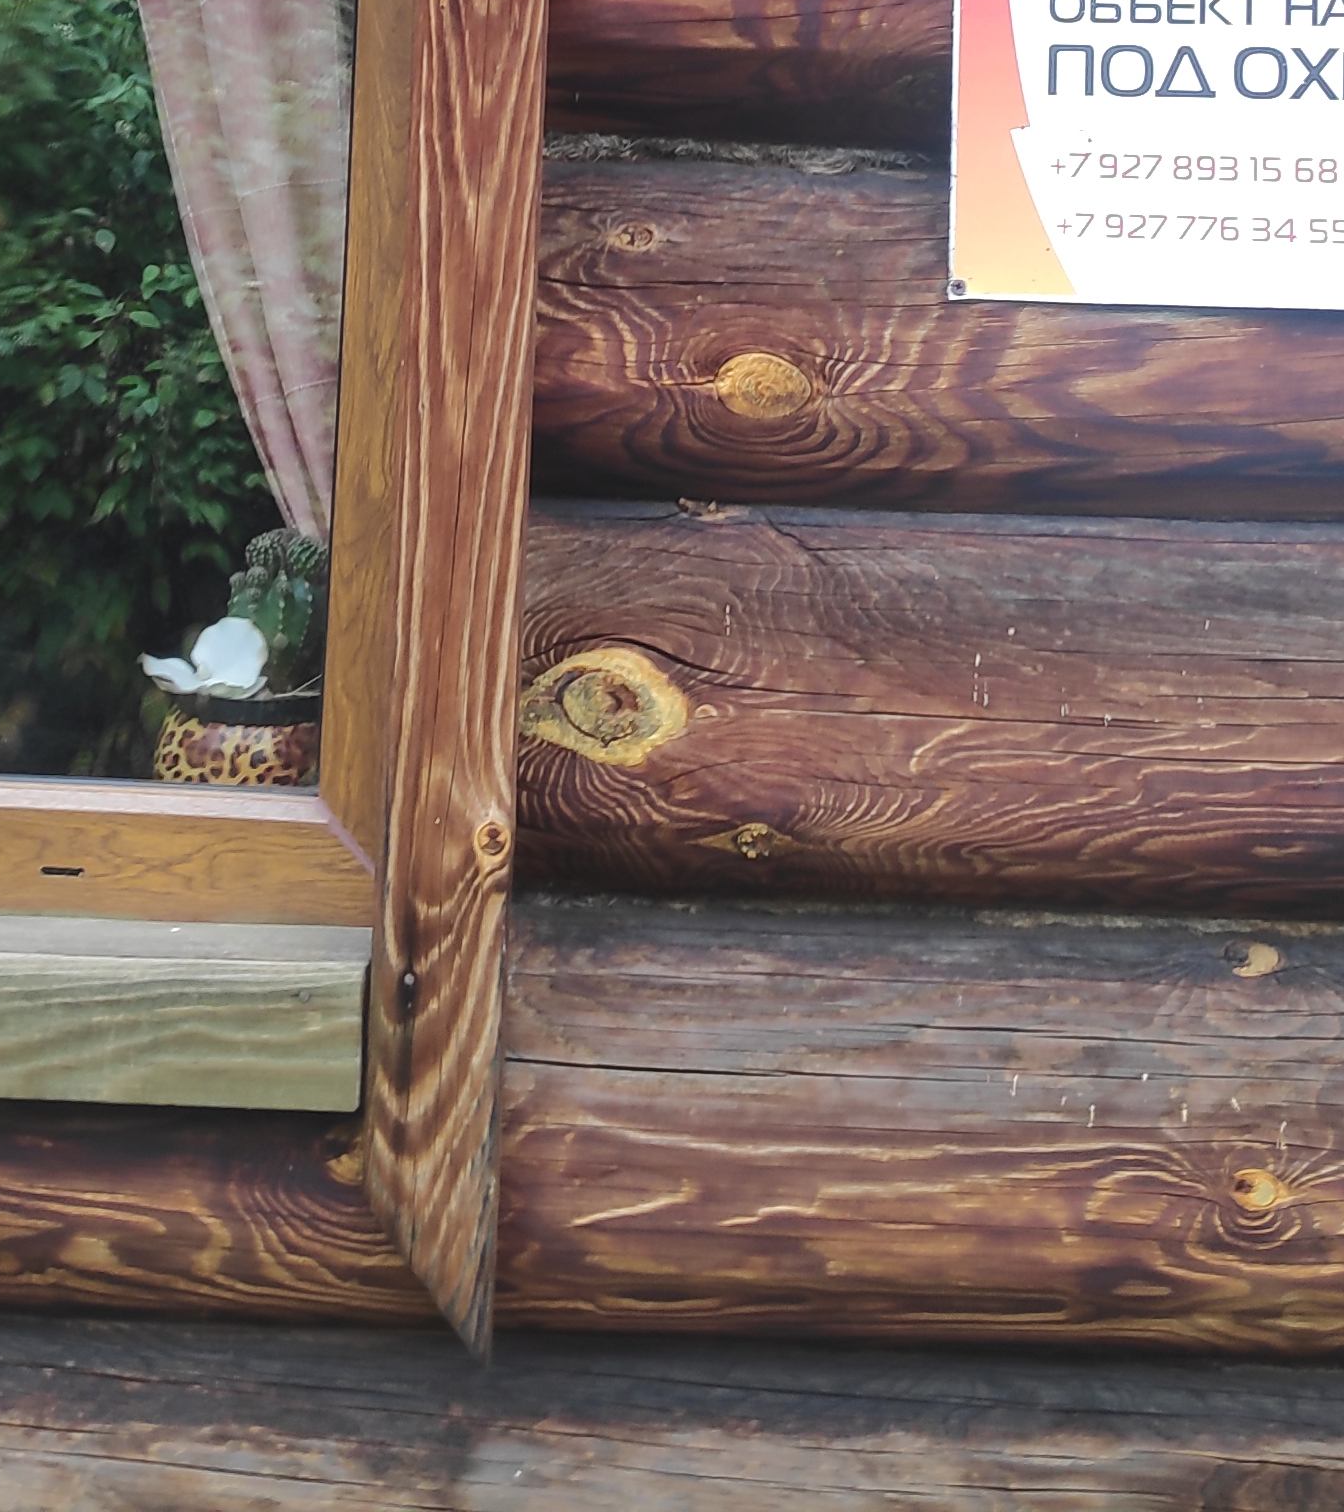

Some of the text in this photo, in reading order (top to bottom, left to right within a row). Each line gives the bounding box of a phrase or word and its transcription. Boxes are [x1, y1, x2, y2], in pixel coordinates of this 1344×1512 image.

[1048, 43, 1216, 99] ПОД
[1050, 154, 1338, 184] +7 927 893 15 68
[1056, 214, 1098, 239] +7
[1104, 214, 1171, 241] 927
[1177, 215, 1240, 242] 776
[1251, 216, 1297, 243] 34
